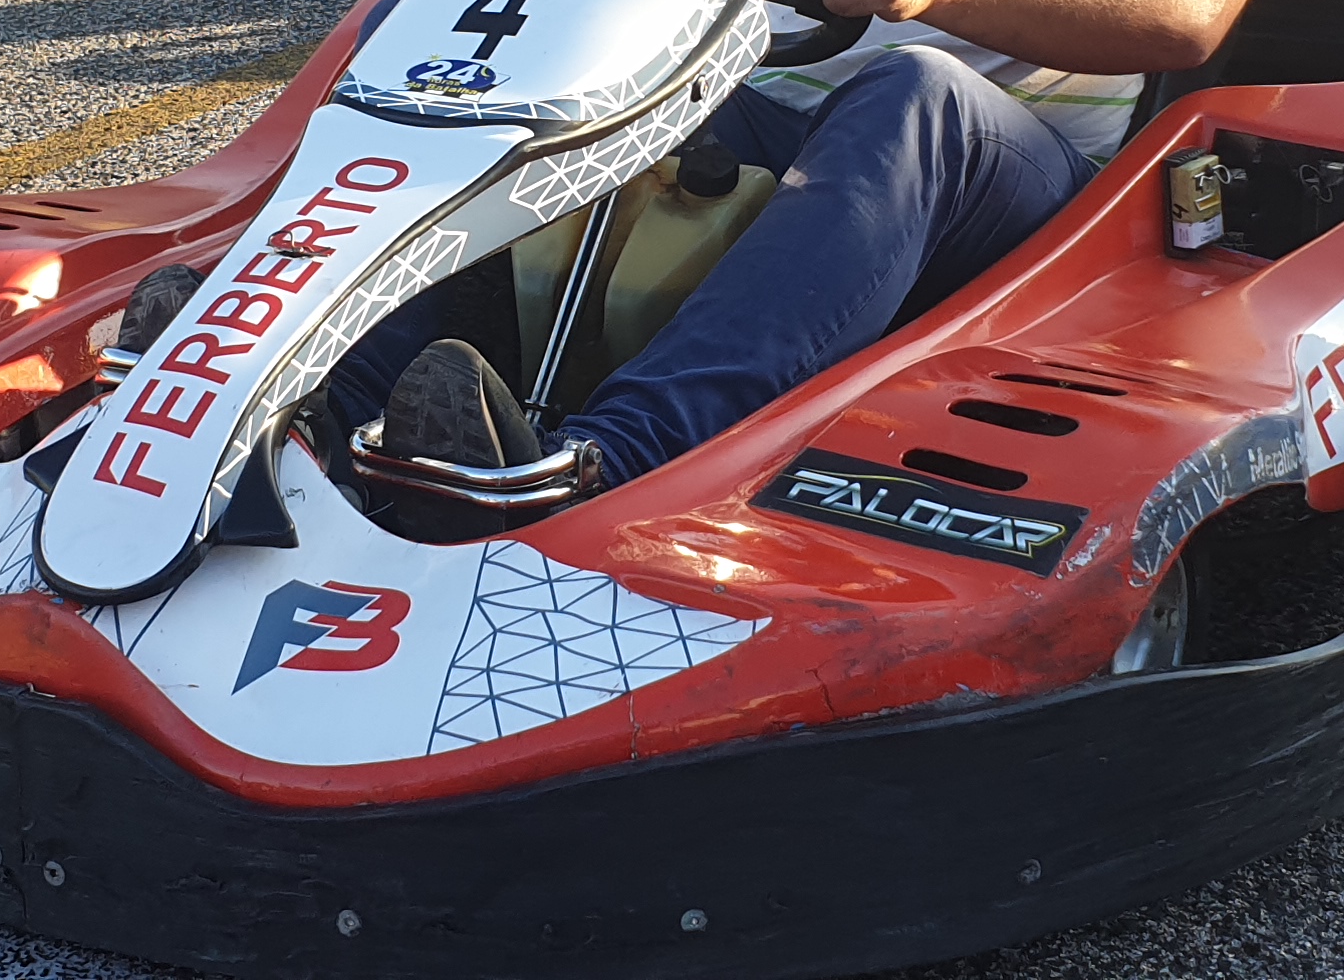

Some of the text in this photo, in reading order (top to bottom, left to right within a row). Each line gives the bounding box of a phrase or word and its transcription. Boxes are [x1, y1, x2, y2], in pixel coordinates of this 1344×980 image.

[416, 60, 482, 85] 24
[92, 156, 410, 498] FERBERTO
[786, 469, 1061, 553] PALOCAR
